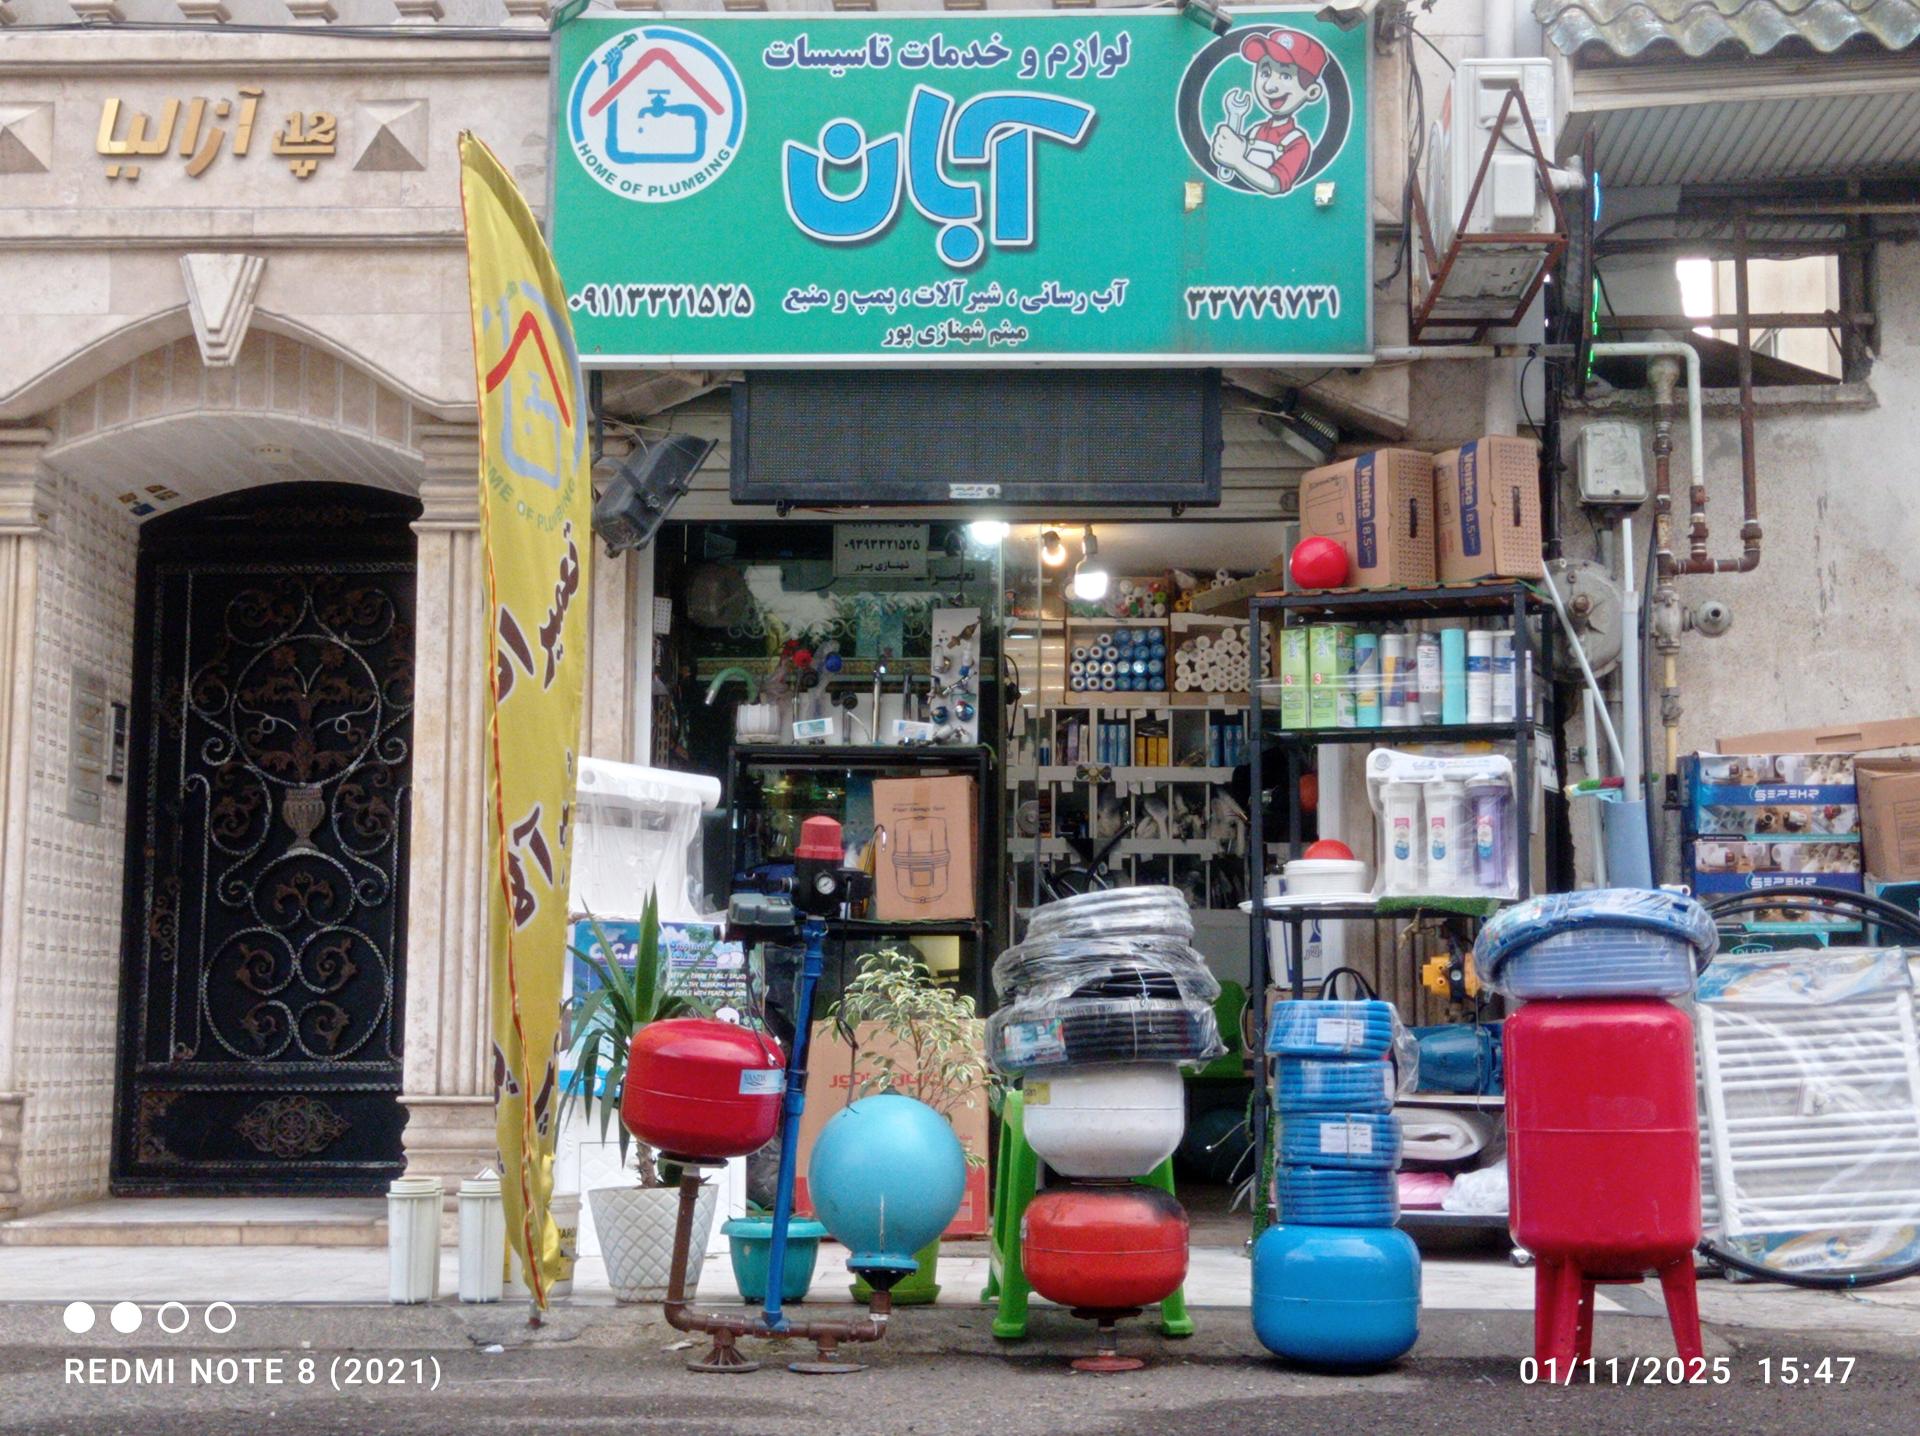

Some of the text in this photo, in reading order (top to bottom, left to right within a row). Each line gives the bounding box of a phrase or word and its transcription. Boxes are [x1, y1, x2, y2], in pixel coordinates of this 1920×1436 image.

[763, 31, 1131, 80] لوازم و خدمات تاسیسات
[95, 86, 265, 180] آزالیا
[284, 111, 337, 144] 12
[578, 143, 731, 197] HOME OF PLUMBING
[780, 83, 1097, 269] آبان
[568, 282, 754, 317] ۰۹۱۱۳۳۲۱۵۲۵
[782, 283, 830, 313] منبع
[833, 289, 847, 312] و
[851, 284, 895, 314] پمپ
[1091, 278, 1129, 313] آب
[1184, 284, 1341, 320] ۳۳۷۷۹۷۳۱
[881, 319, 1029, 349] میثم شهنازی پور
[1360, 465, 1373, 518] Venice
[1754, 789, 1820, 802] SEPEHR
[1750, 876, 1817, 890] SEPEHR
